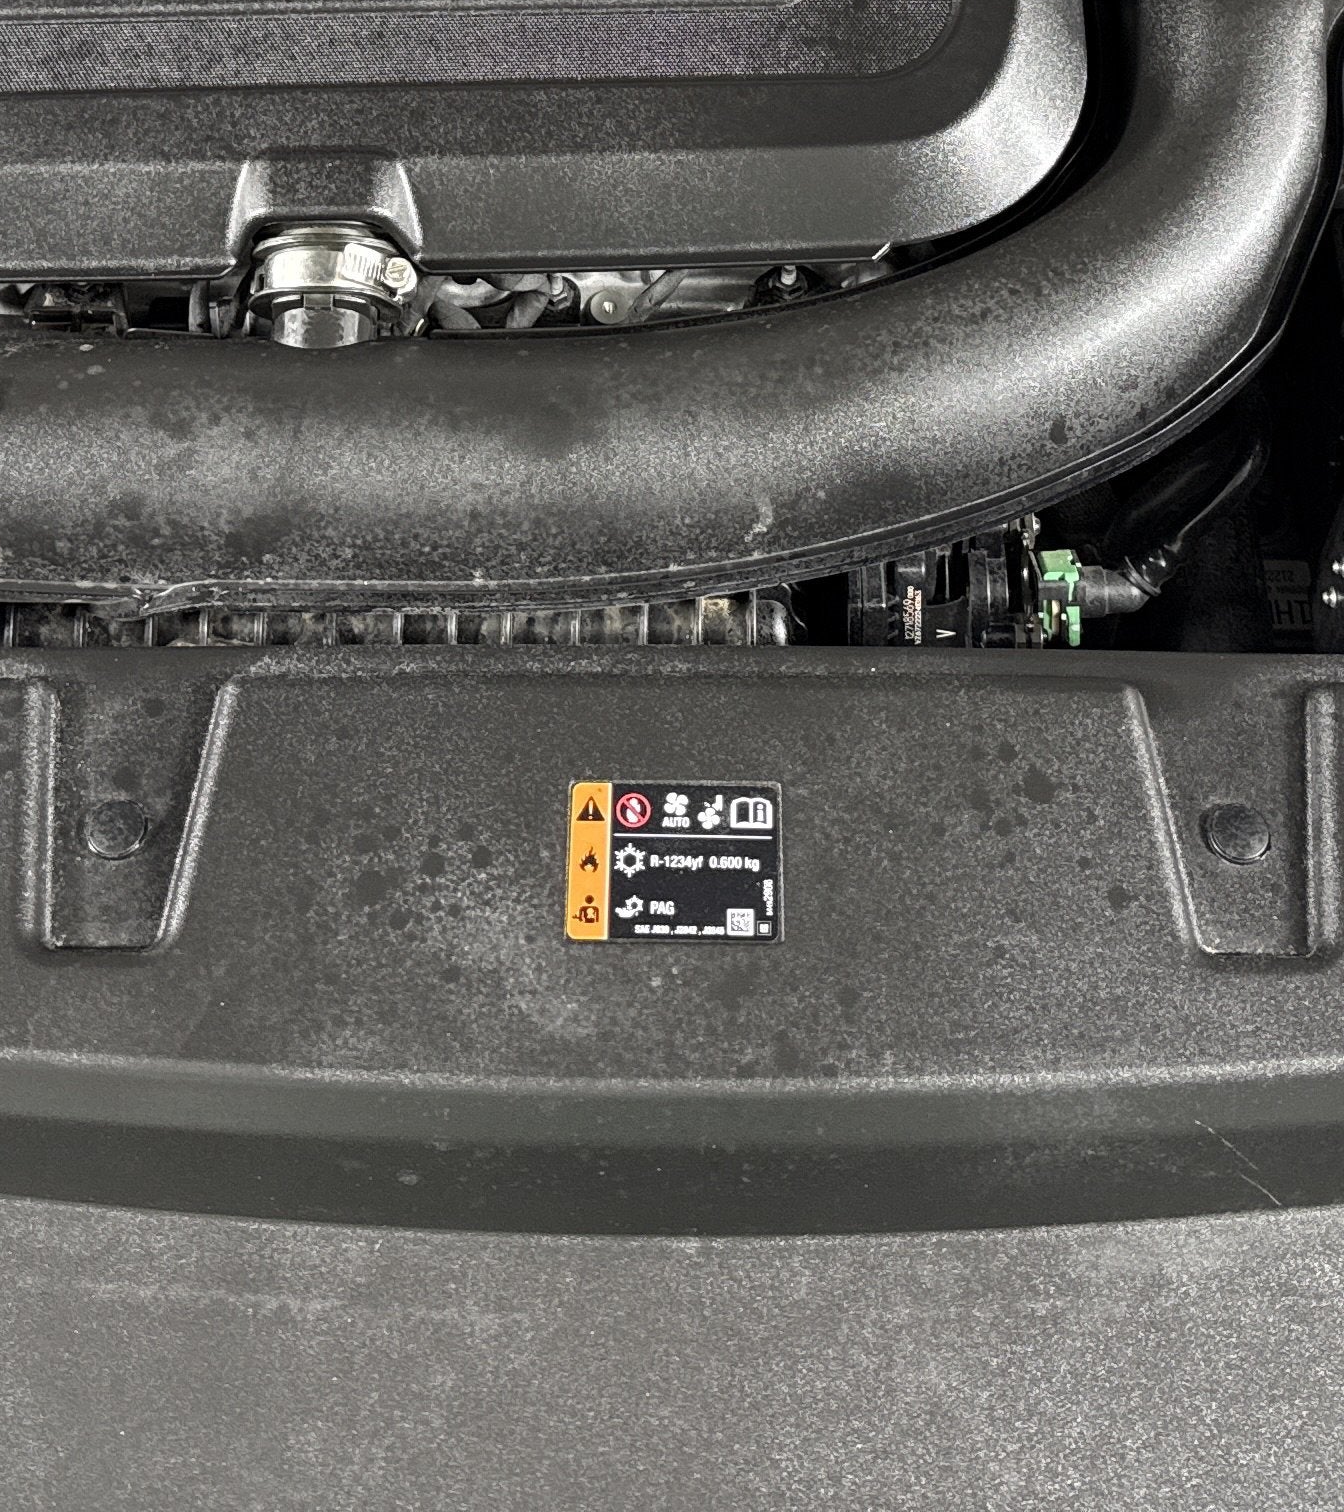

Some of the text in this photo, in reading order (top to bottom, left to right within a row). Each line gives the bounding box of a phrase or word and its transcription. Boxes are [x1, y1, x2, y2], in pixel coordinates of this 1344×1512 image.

[662, 817, 690, 828] AUTO
[650, 854, 760, 872] R-1234yf 0.600 kg
[650, 900, 675, 916] PAG
